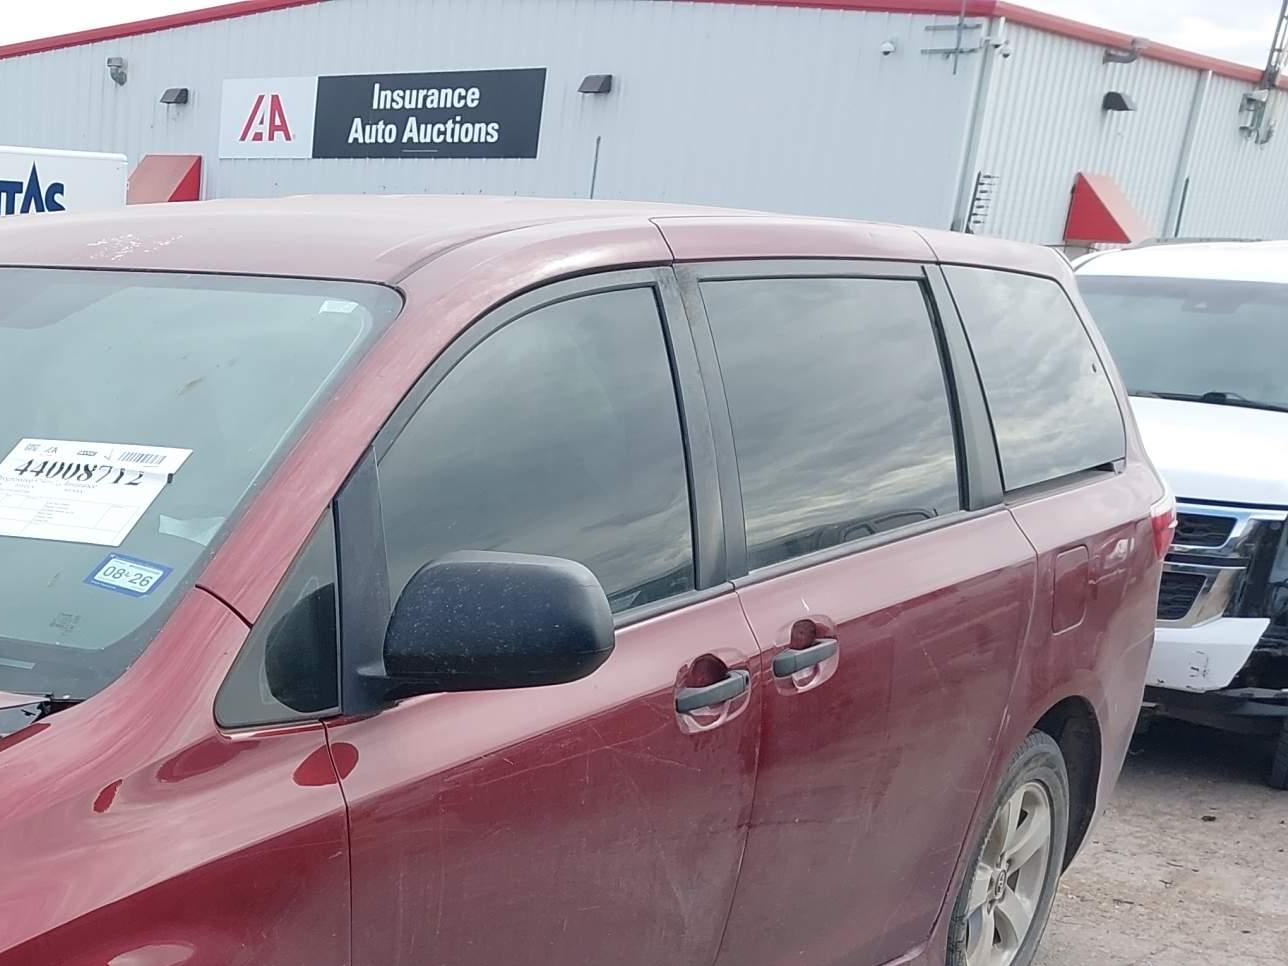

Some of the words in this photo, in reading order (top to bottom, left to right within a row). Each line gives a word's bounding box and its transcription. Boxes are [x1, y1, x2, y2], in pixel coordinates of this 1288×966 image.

[372, 82, 480, 110] Insurance
[348, 117, 397, 144] Auto
[401, 115, 500, 144] Auctions
[14, 459, 145, 486] 44008712
